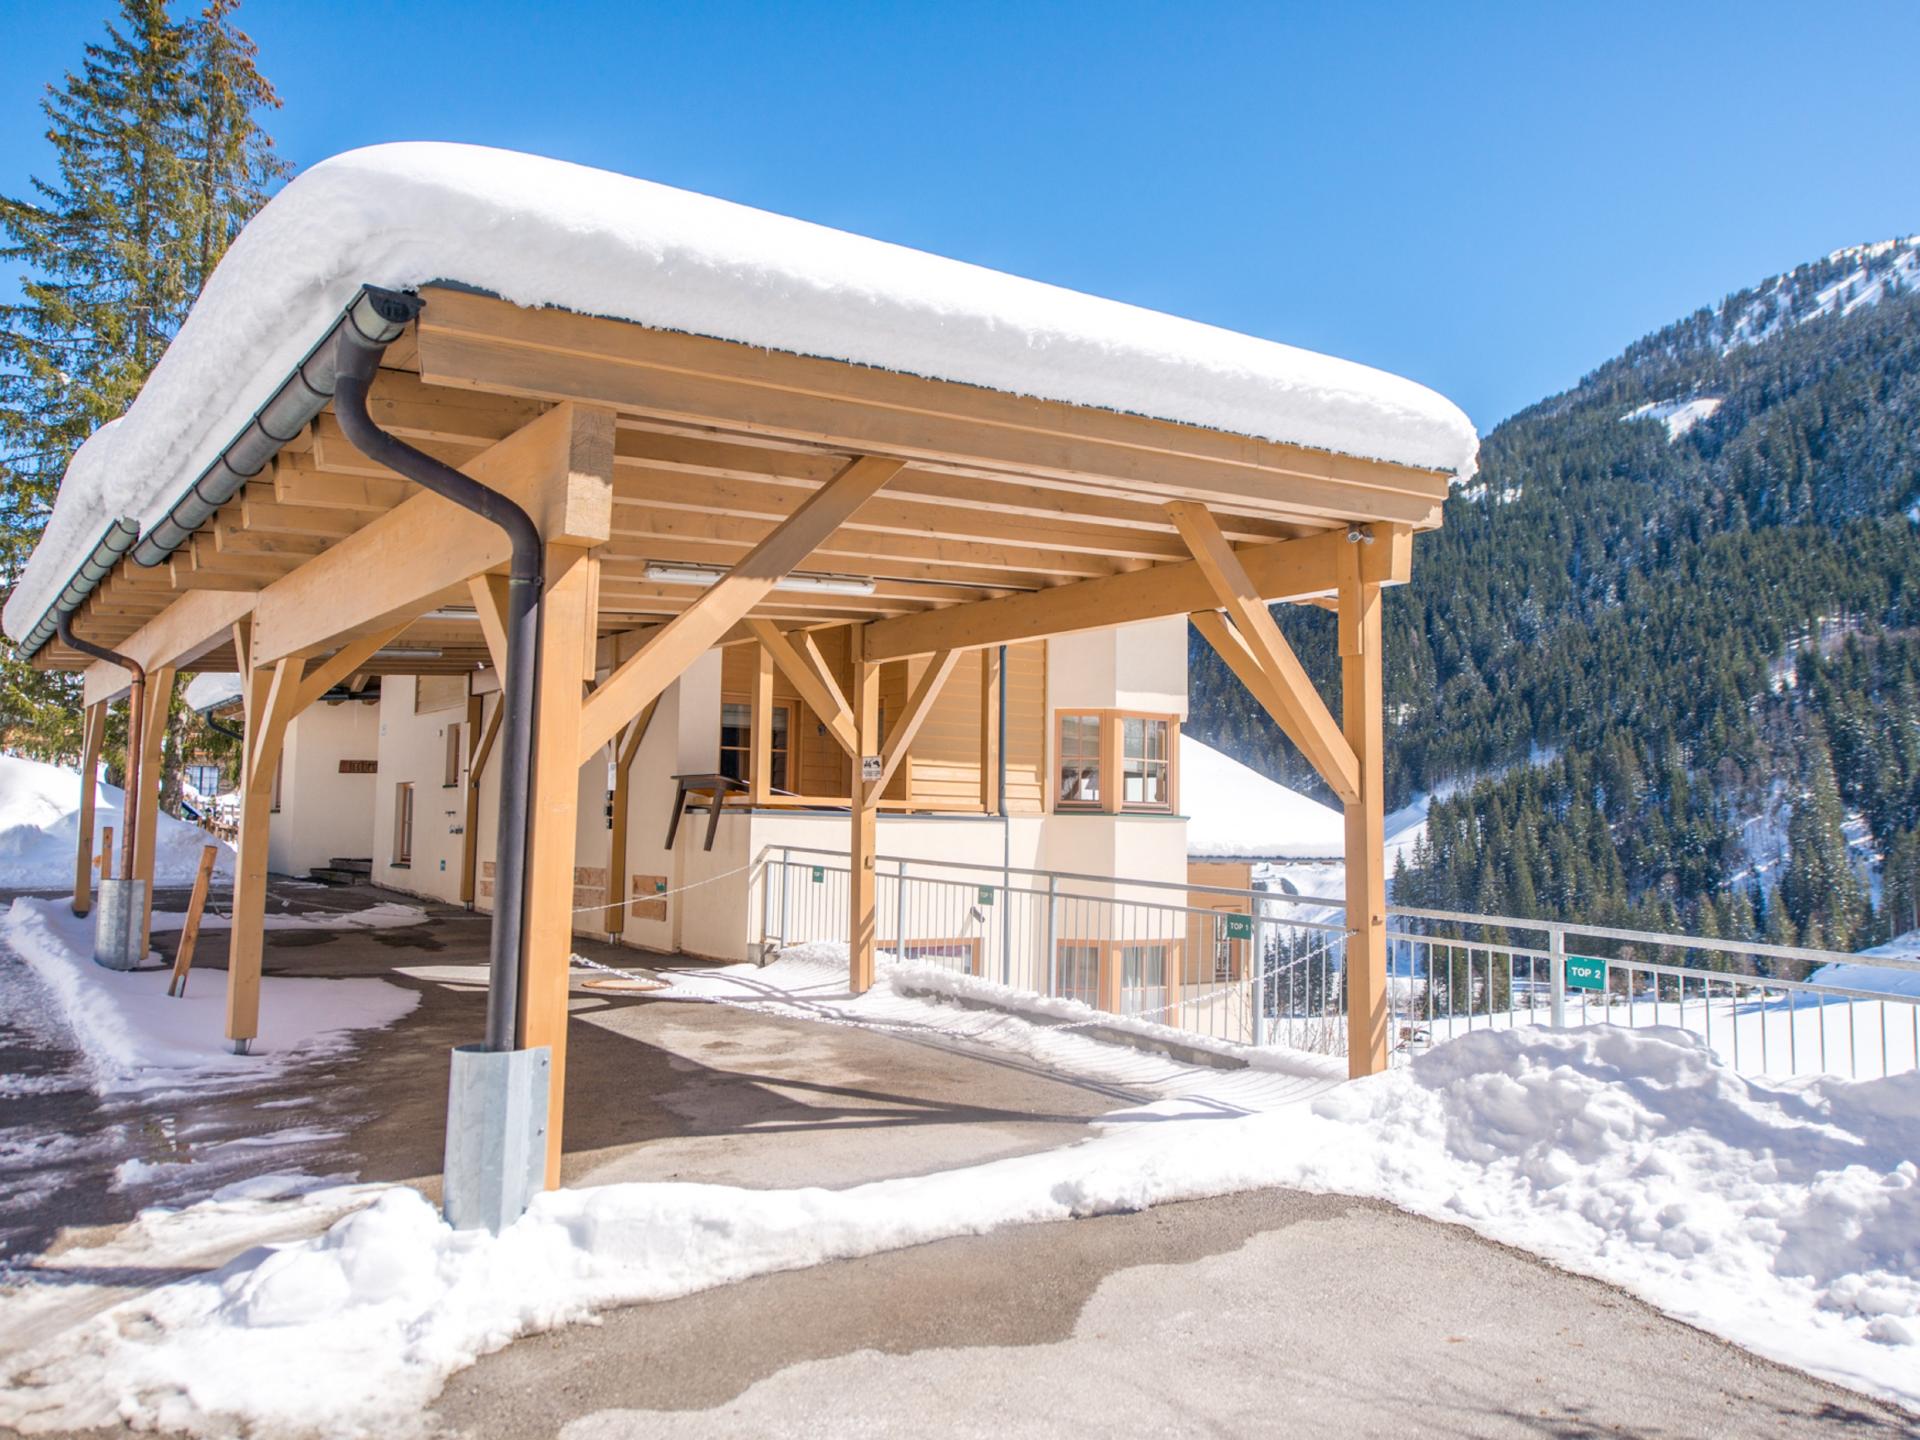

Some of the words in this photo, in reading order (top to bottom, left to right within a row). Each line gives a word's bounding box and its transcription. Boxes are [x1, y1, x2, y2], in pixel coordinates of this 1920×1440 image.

[1230, 921, 1243, 930] TOP
[1571, 966, 1592, 977] TOP
[1594, 969, 1601, 979] 2
